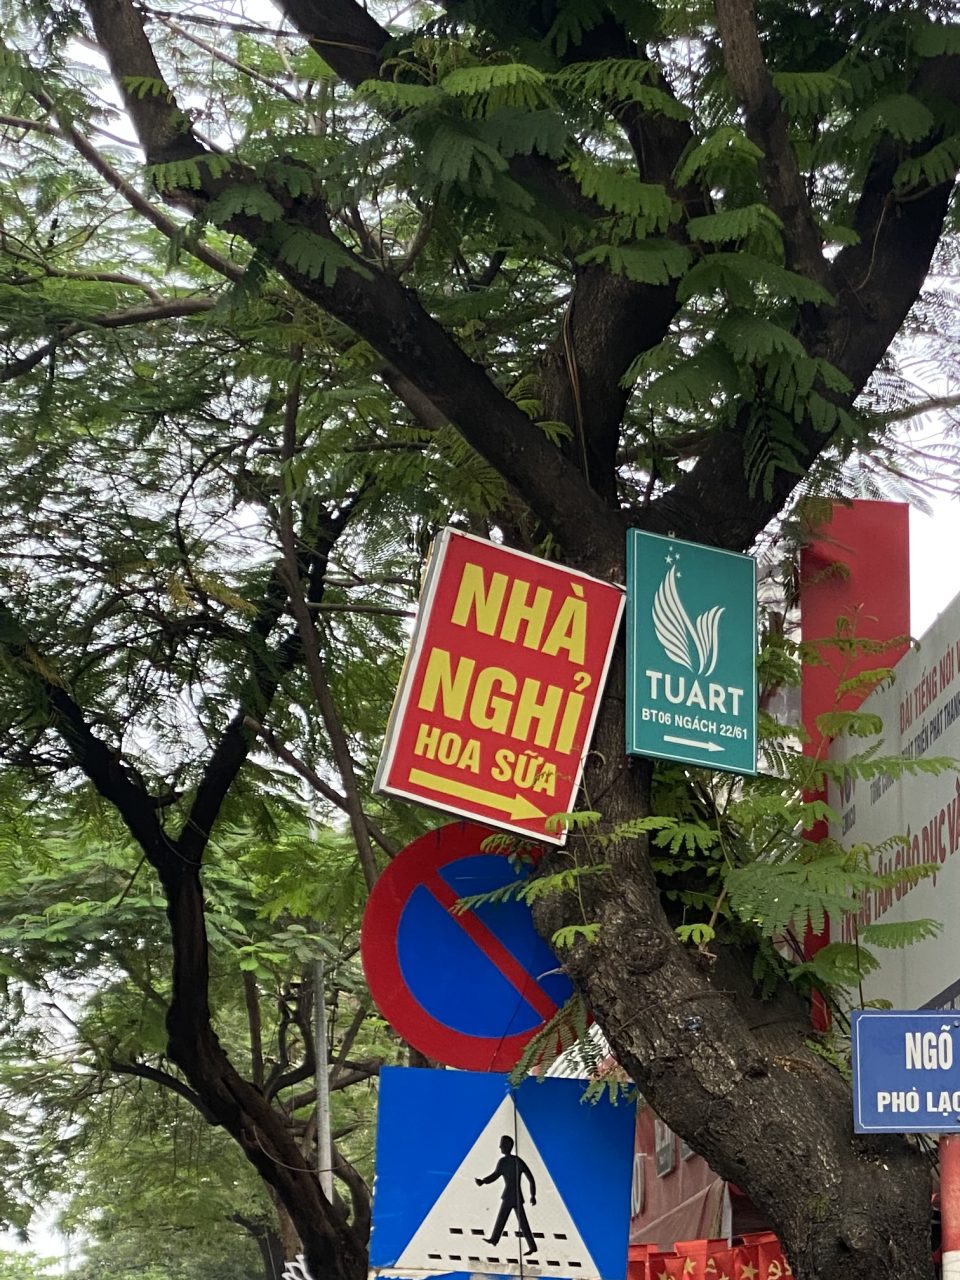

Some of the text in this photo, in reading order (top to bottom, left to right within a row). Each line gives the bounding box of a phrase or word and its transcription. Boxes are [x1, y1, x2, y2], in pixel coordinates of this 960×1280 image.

[450, 562, 588, 665] NHÀ
[417, 648, 592, 755] NGHỈ
[646, 670, 743, 717] TUART
[914, 666, 937, 720] TIẾNG
[939, 642, 954, 694] NÓI
[414, 724, 559, 797] HOA SỮA
[641, 708, 748, 741] BT06 NGÁCH 22/61
[922, 808, 946, 888] DỤC
[905, 1024, 953, 1070] NGÕ
